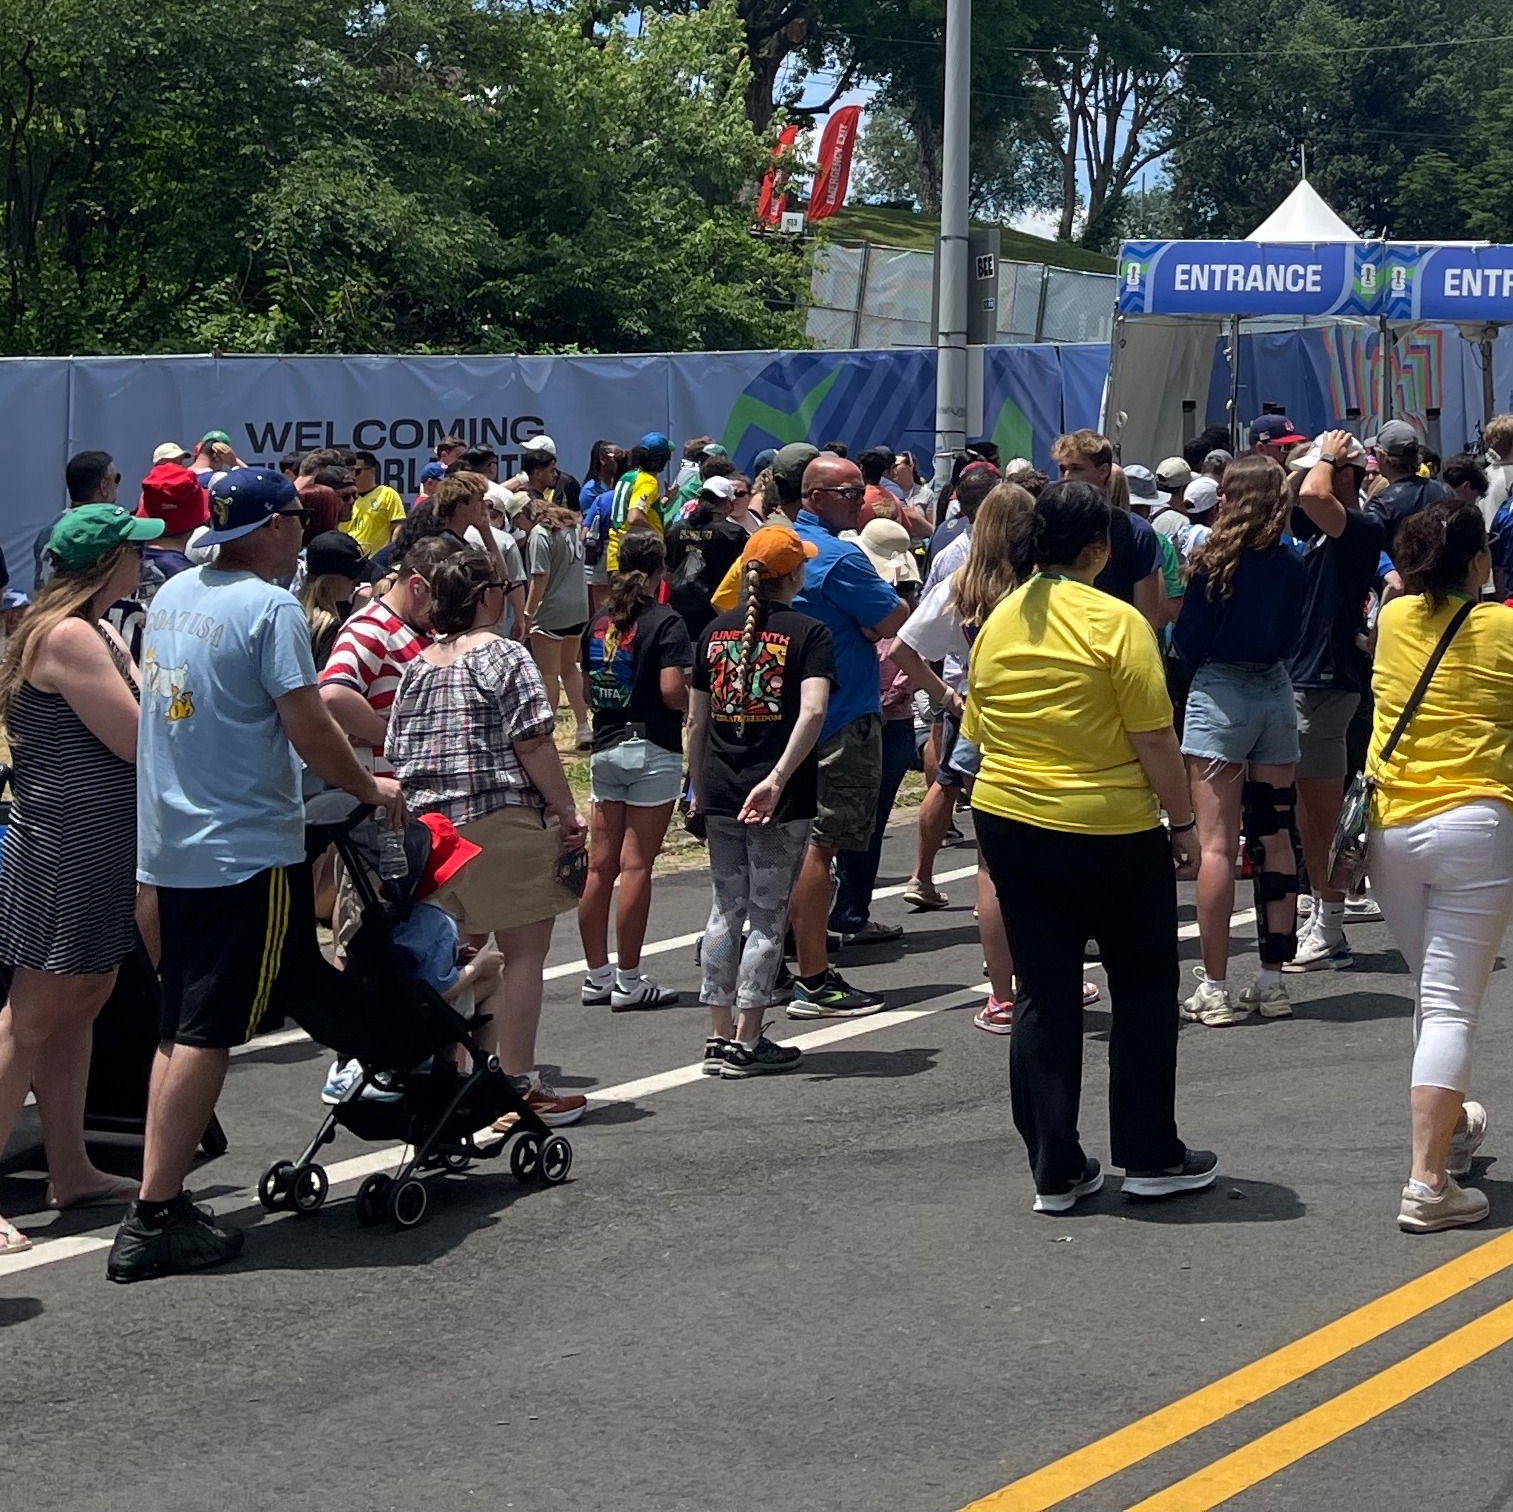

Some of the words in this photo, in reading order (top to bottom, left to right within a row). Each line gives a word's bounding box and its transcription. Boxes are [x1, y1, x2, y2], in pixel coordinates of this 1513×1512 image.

[977, 255, 993, 278] BEE
[1174, 264, 1322, 292] ENTRANCE
[244, 415, 545, 454] WELCOMING
[600, 688, 621, 699] FIFA
